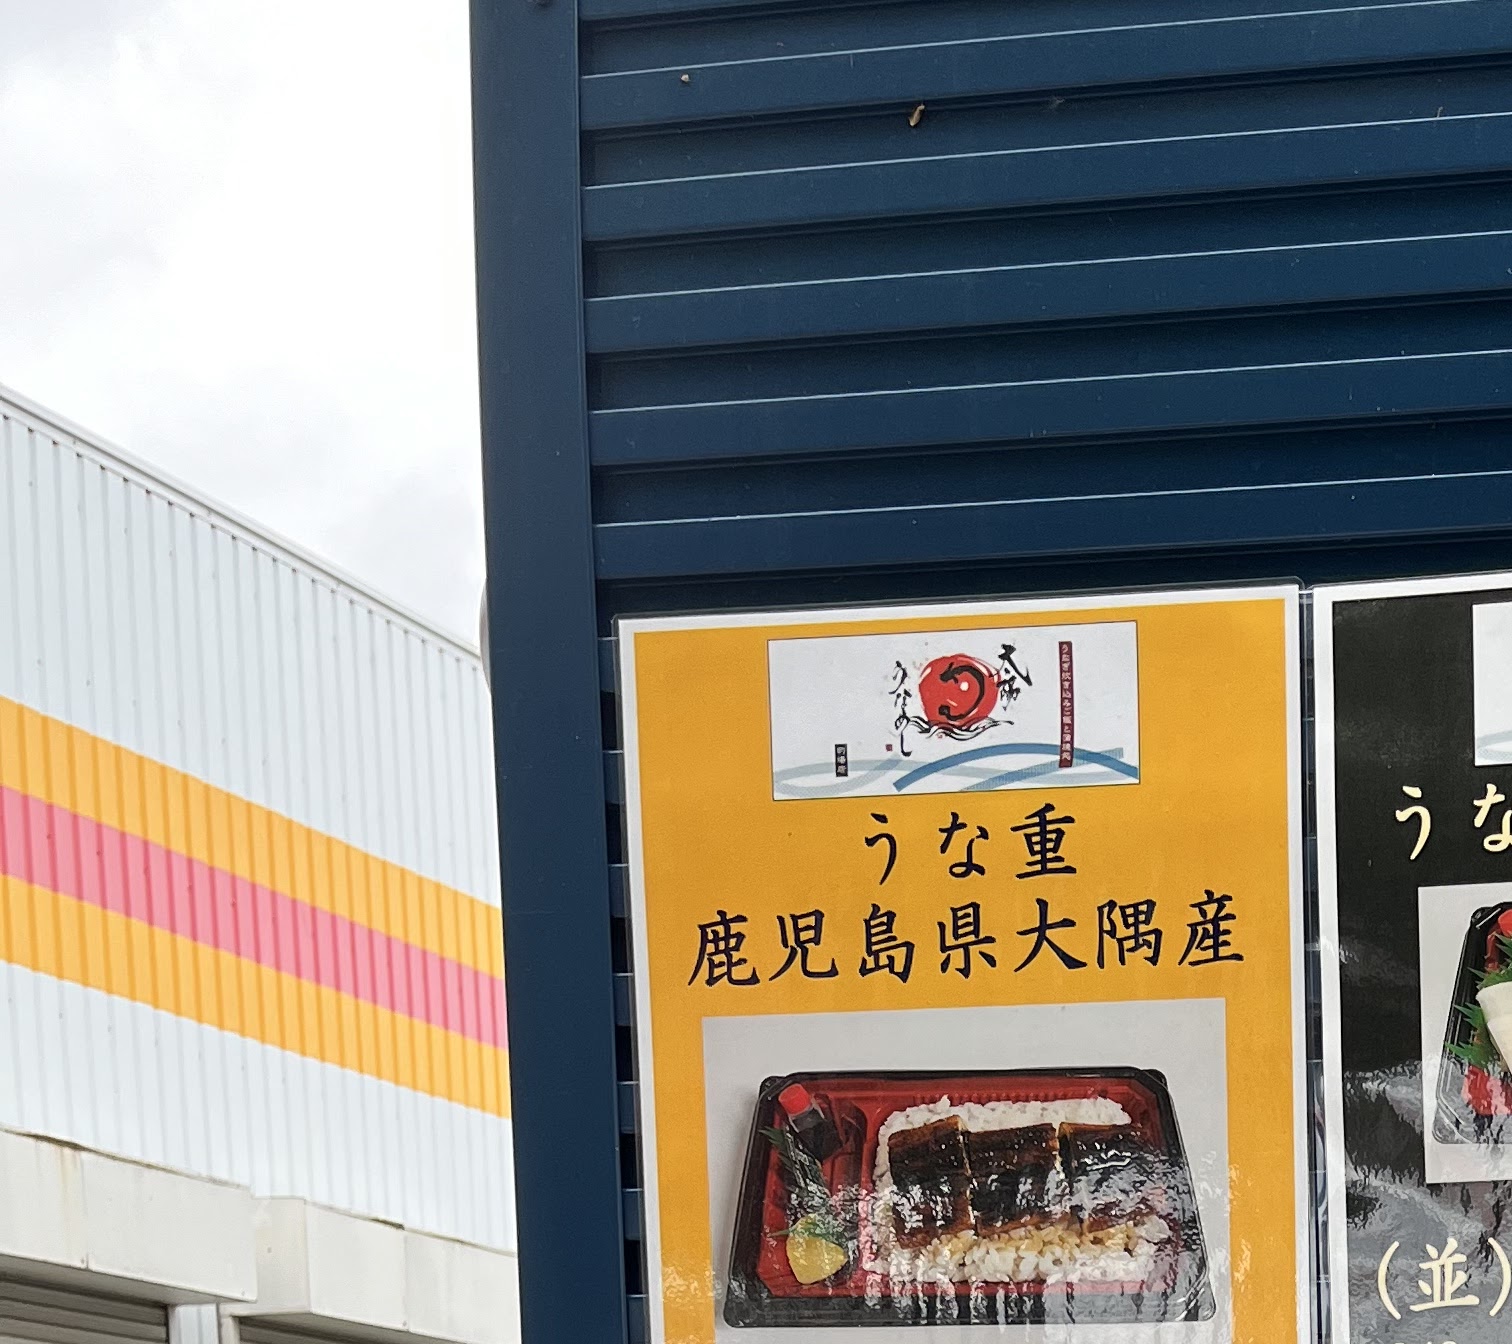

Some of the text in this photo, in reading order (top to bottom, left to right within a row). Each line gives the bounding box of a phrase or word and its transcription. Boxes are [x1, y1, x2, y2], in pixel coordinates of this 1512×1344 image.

[863, 802, 1078, 886] うな重
[687, 889, 1246, 989] 鹿児島県大隅産
[1376, 1236, 1512, 1320] （並）
